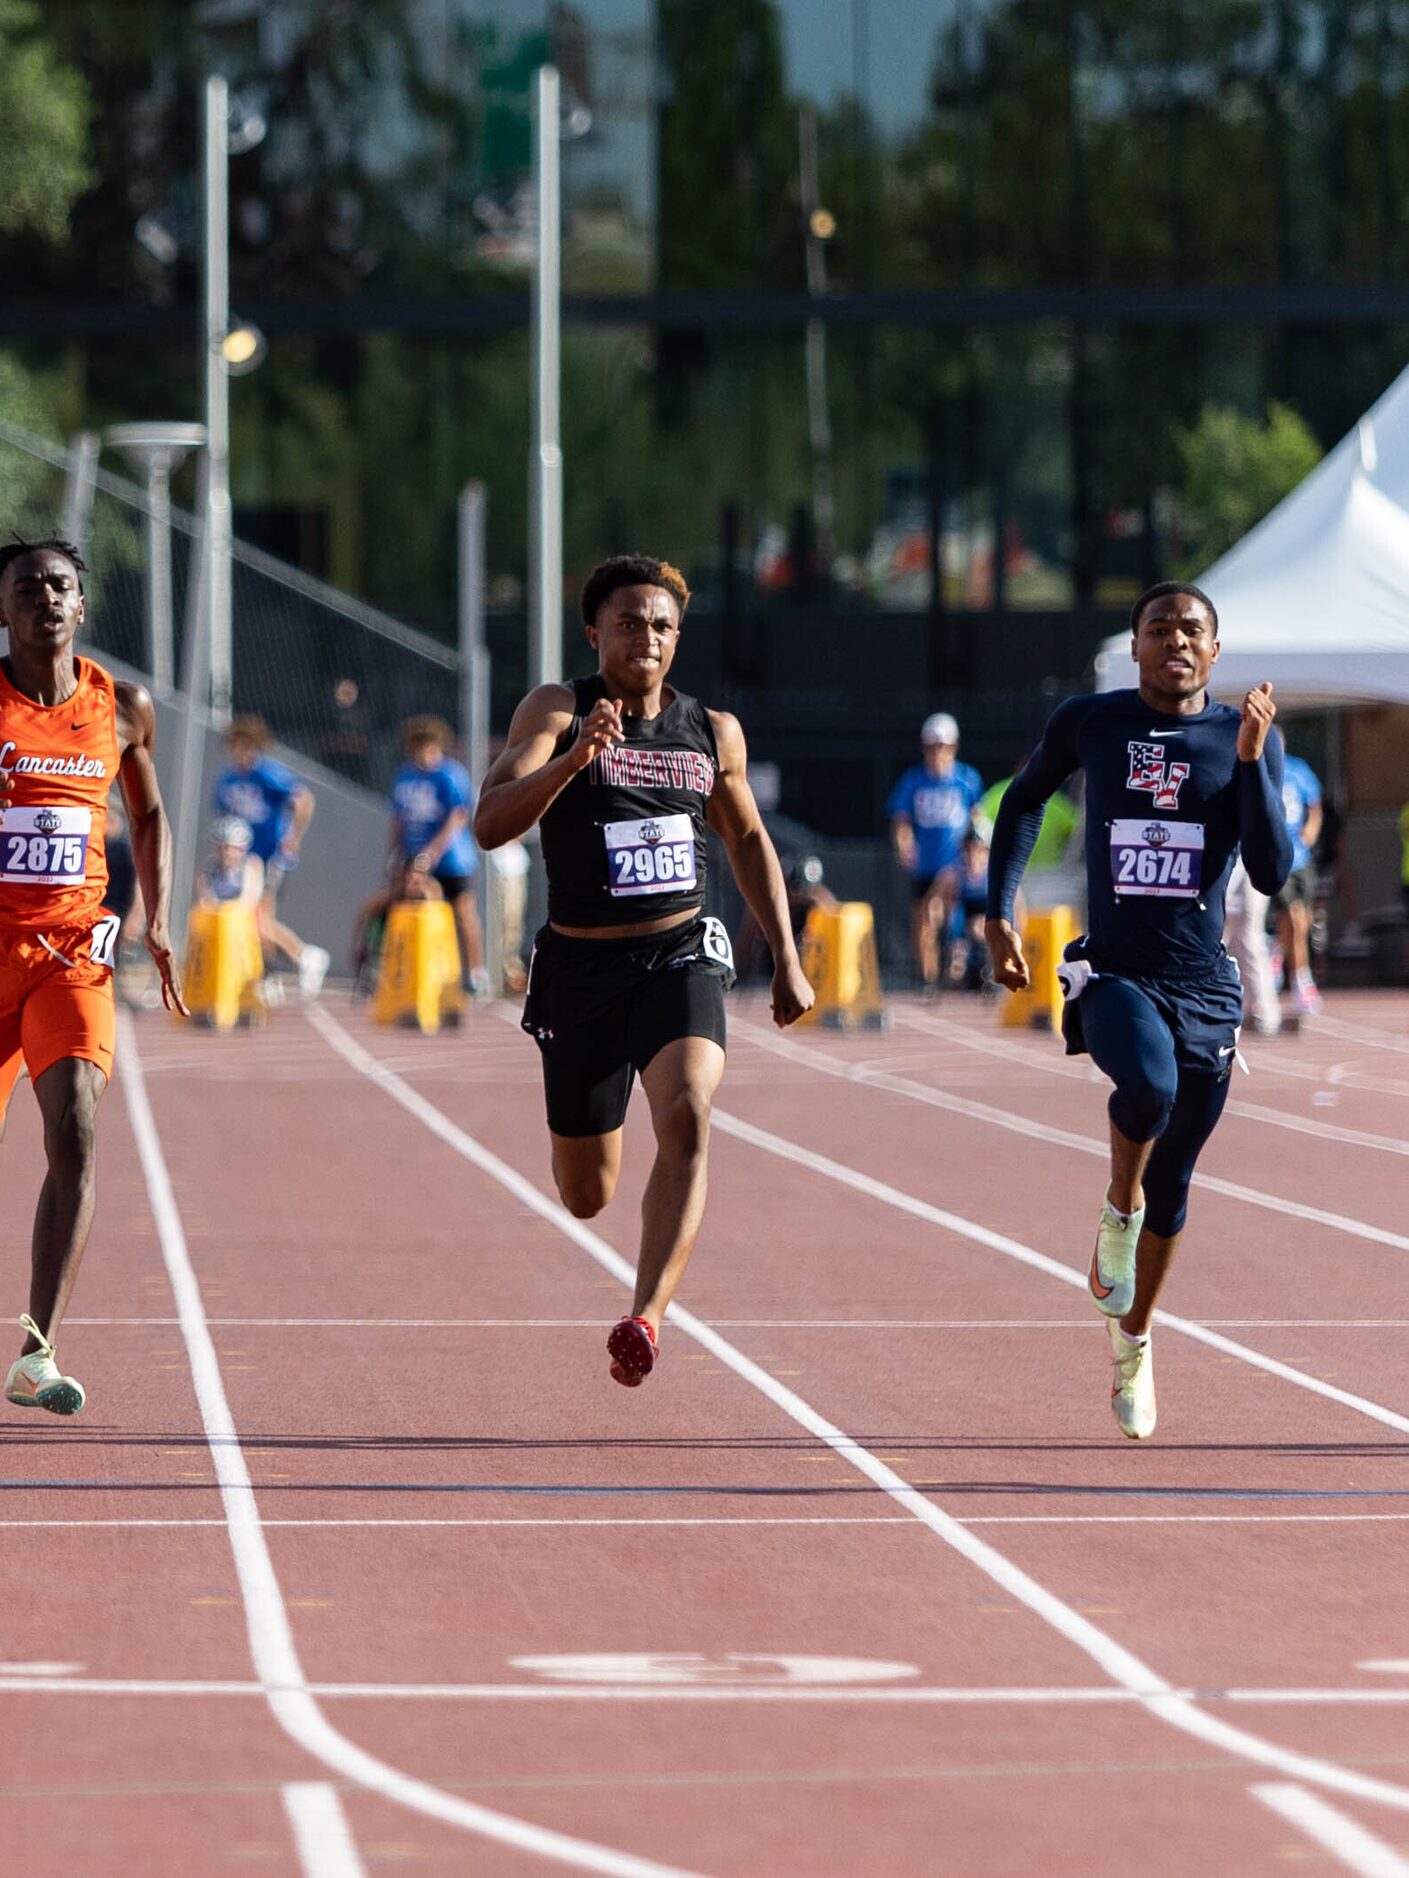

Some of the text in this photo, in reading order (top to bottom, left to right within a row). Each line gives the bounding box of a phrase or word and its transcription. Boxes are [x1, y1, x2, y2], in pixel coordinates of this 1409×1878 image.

[1126, 741, 1191, 811] EV
[7, 836, 82, 873] 2875
[615, 844, 692, 884] 2965
[1118, 849, 1191, 885] 2674
